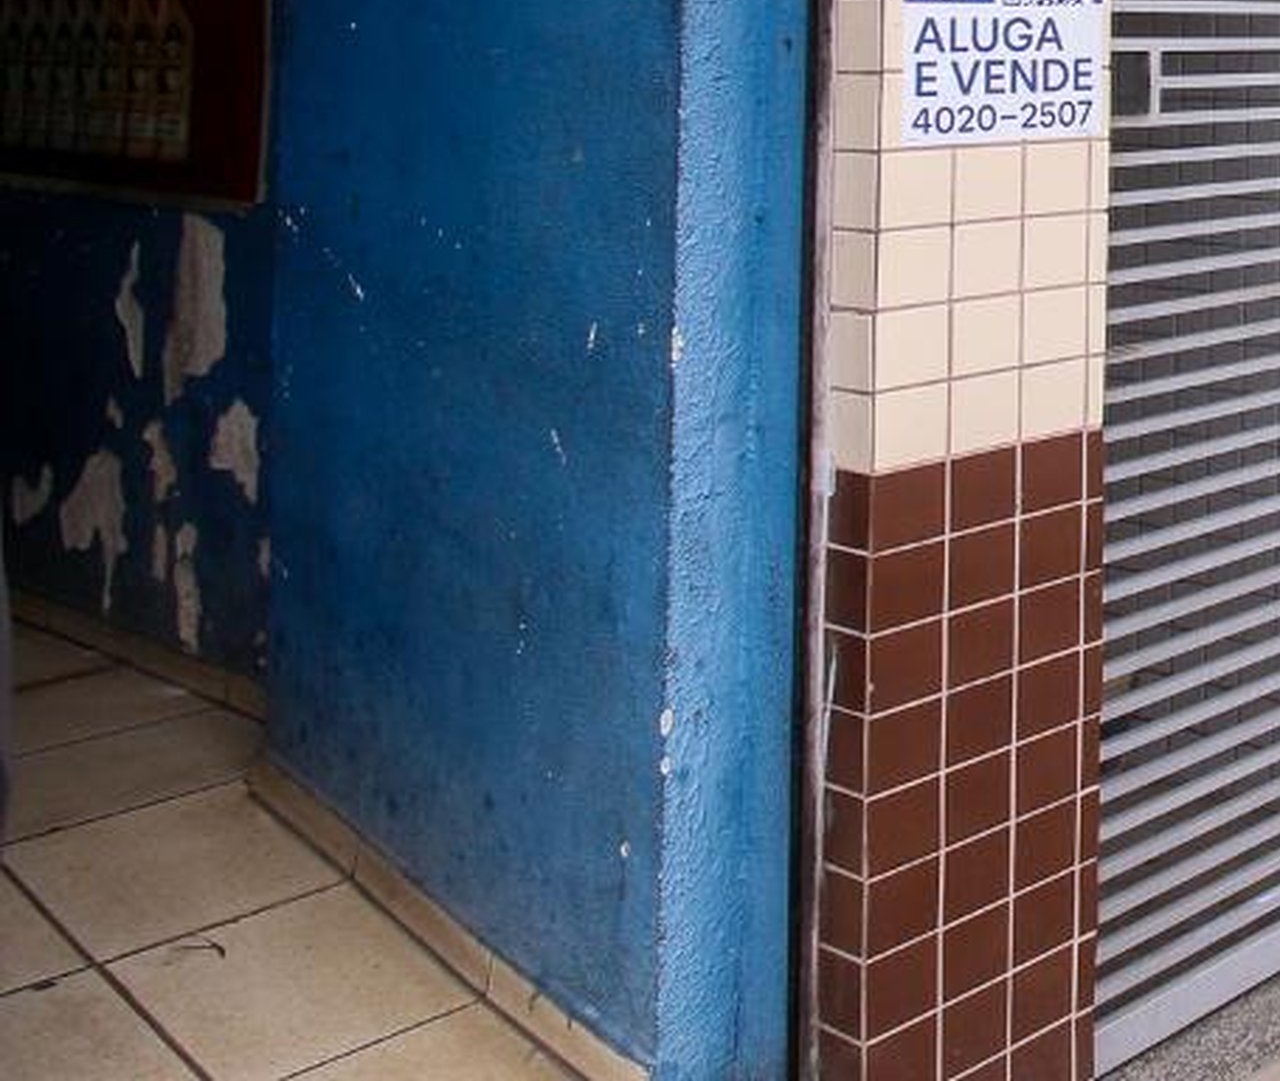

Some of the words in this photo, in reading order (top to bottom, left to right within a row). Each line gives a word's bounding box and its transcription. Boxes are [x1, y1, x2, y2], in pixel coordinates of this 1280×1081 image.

[913, 17, 1064, 54] ALUGA
[915, 61, 938, 97] E
[952, 58, 1094, 95] VENDE
[911, 101, 1094, 134] 4020-2507
